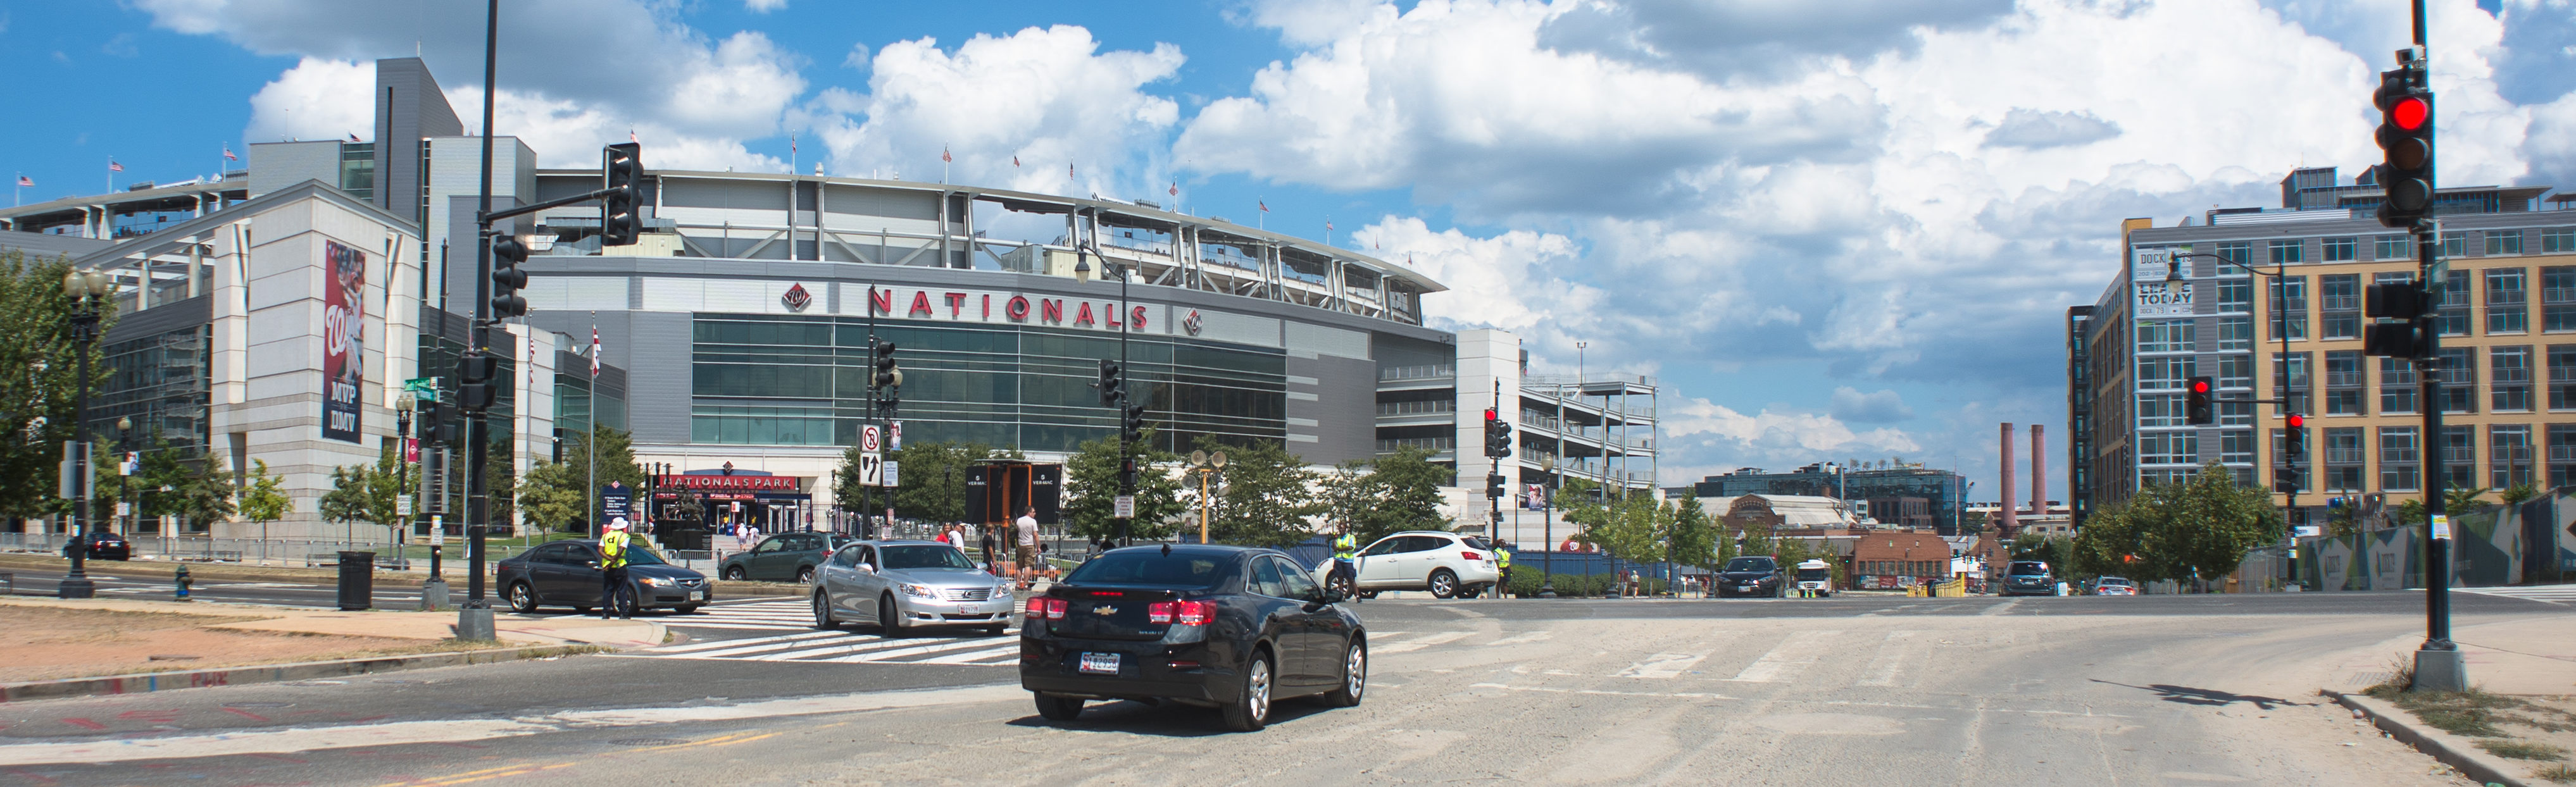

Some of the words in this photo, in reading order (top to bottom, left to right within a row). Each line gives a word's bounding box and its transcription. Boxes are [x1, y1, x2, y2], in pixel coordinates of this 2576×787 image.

[2141, 254, 2166, 264] DOCK
[2139, 283, 2191, 294] LEAE
[2138, 294, 2192, 305] TODAY
[868, 288, 1147, 329] NATIONALS
[326, 304, 347, 357] W
[331, 381, 356, 404] MVP
[330, 409, 356, 432] DMV
[663, 477, 750, 487] NATIONALS
[754, 478, 791, 487] PARK
